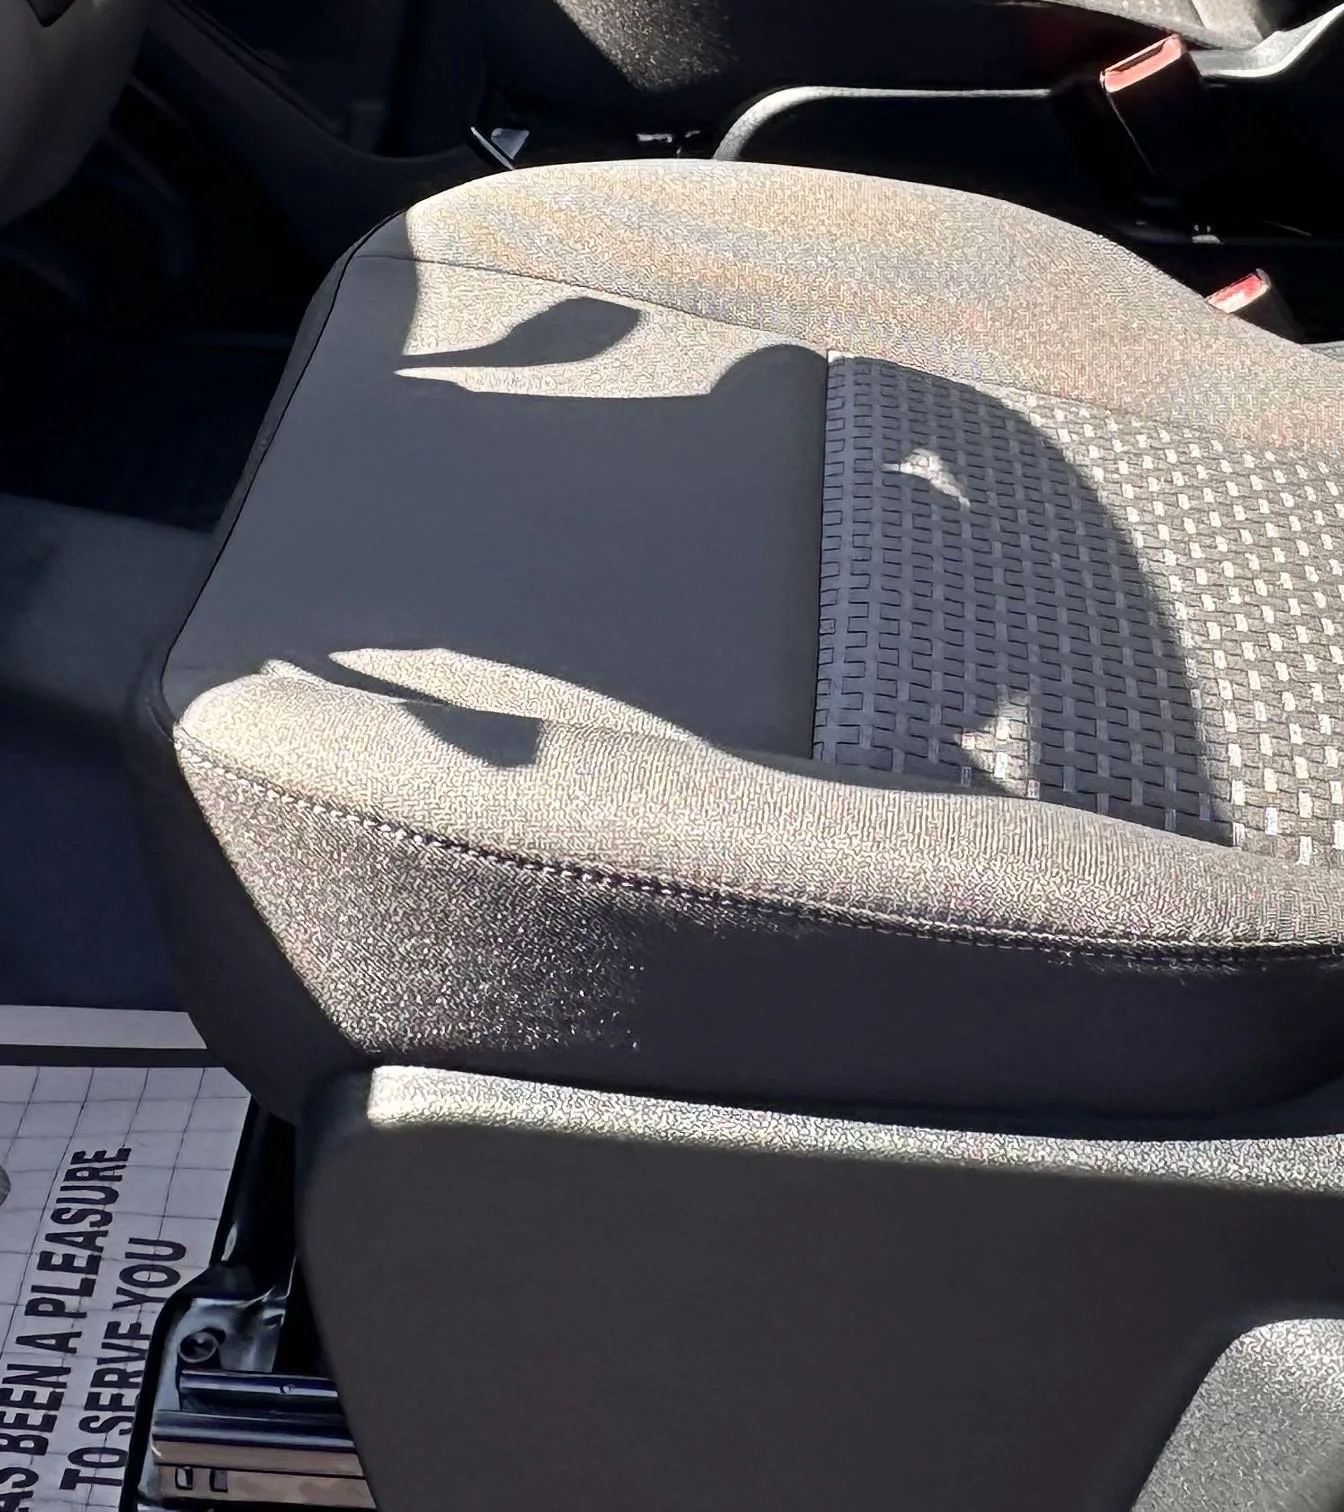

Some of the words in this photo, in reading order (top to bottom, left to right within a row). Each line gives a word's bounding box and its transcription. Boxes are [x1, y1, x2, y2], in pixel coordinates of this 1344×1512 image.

[24, 1147, 133, 1319] PLEASURE
[111, 1237, 187, 1312] YOU
[15, 1331, 83, 1354] A
[78, 1320, 153, 1437] SERVE
[59, 1446, 129, 1490] TO
